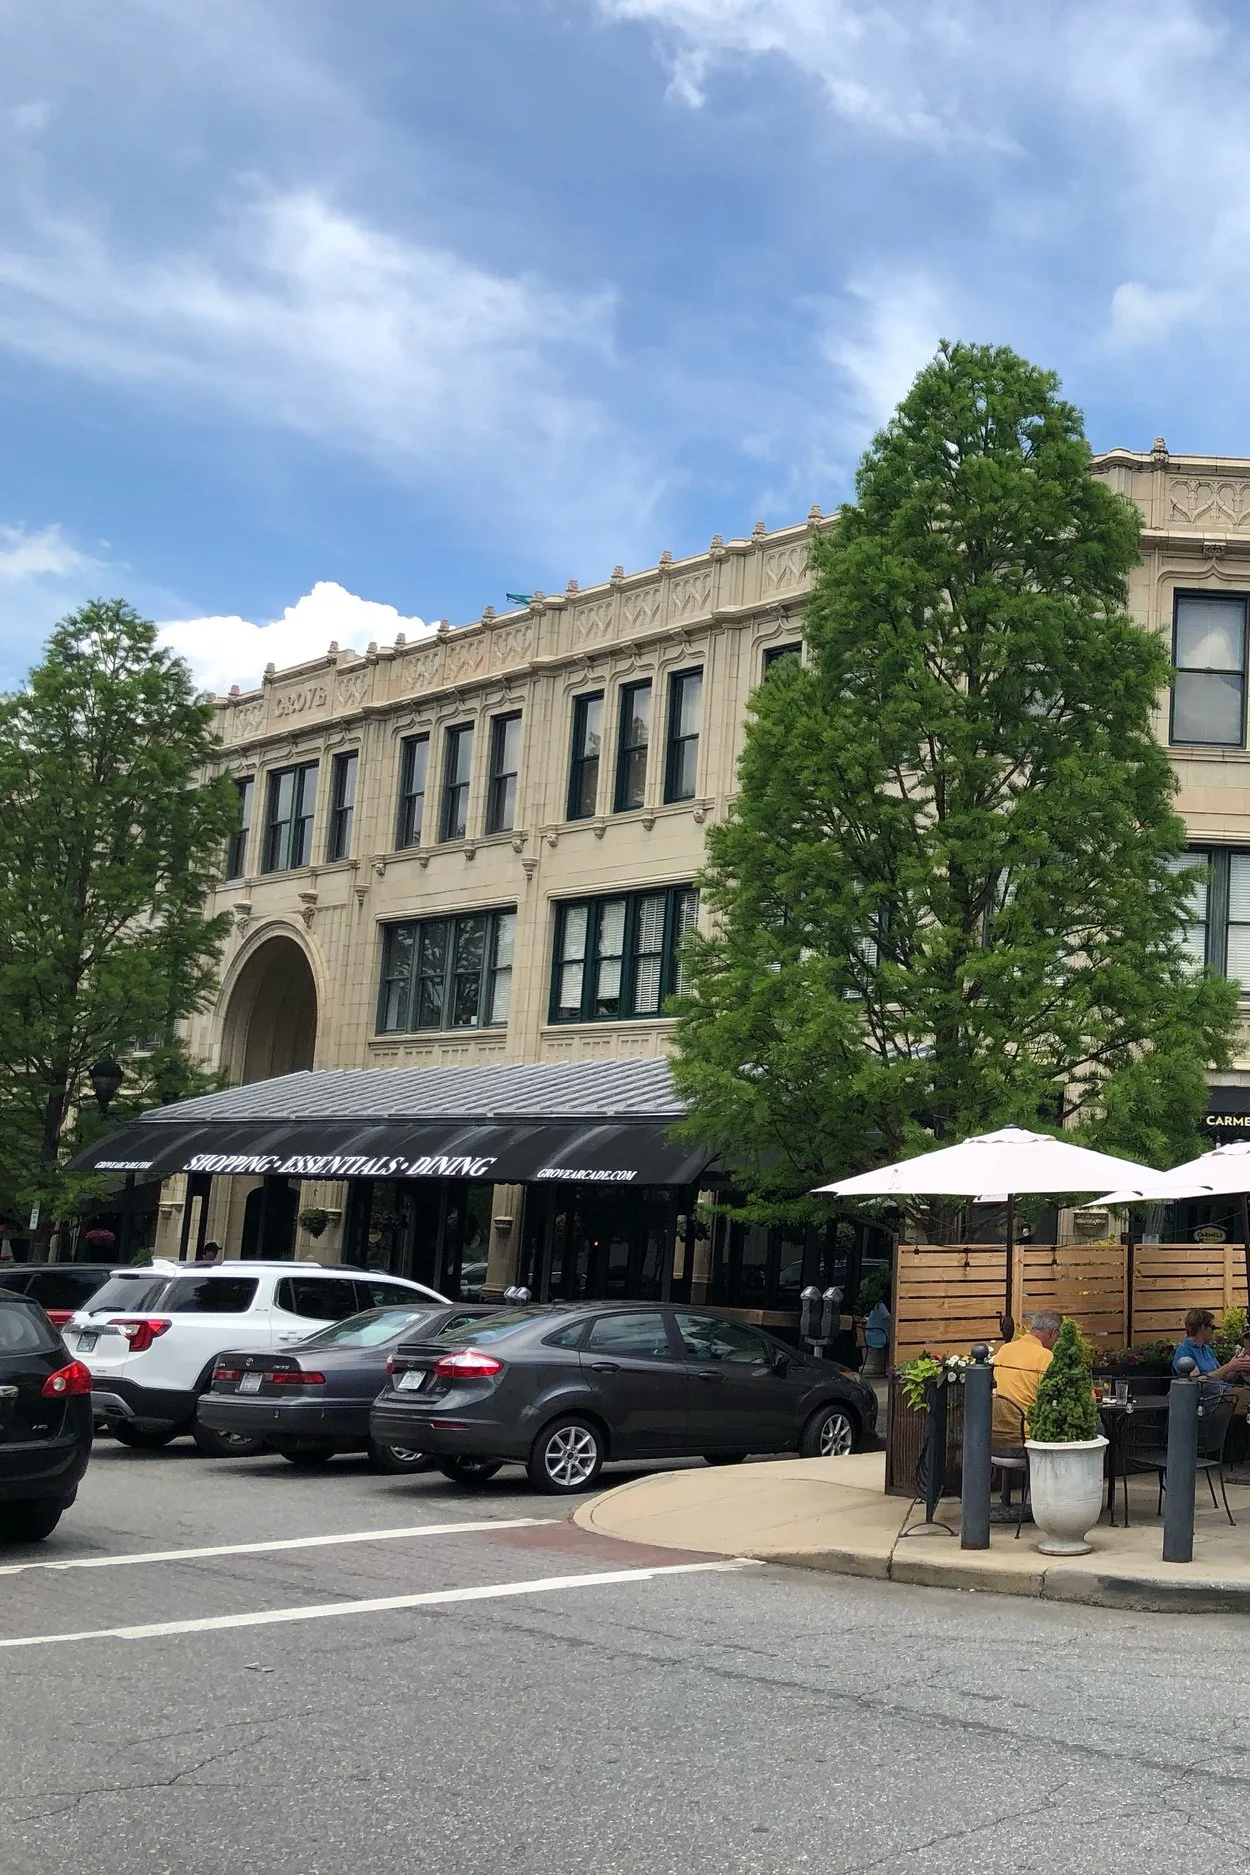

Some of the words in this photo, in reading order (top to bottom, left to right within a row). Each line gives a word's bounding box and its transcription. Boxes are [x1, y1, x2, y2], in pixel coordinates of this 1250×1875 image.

[275, 687, 327, 718] GROVE
[183, 1154, 277, 1172] SHOPPING
[278, 1156, 405, 1175] ESSENTIALS
[405, 1156, 497, 1176] DINING
